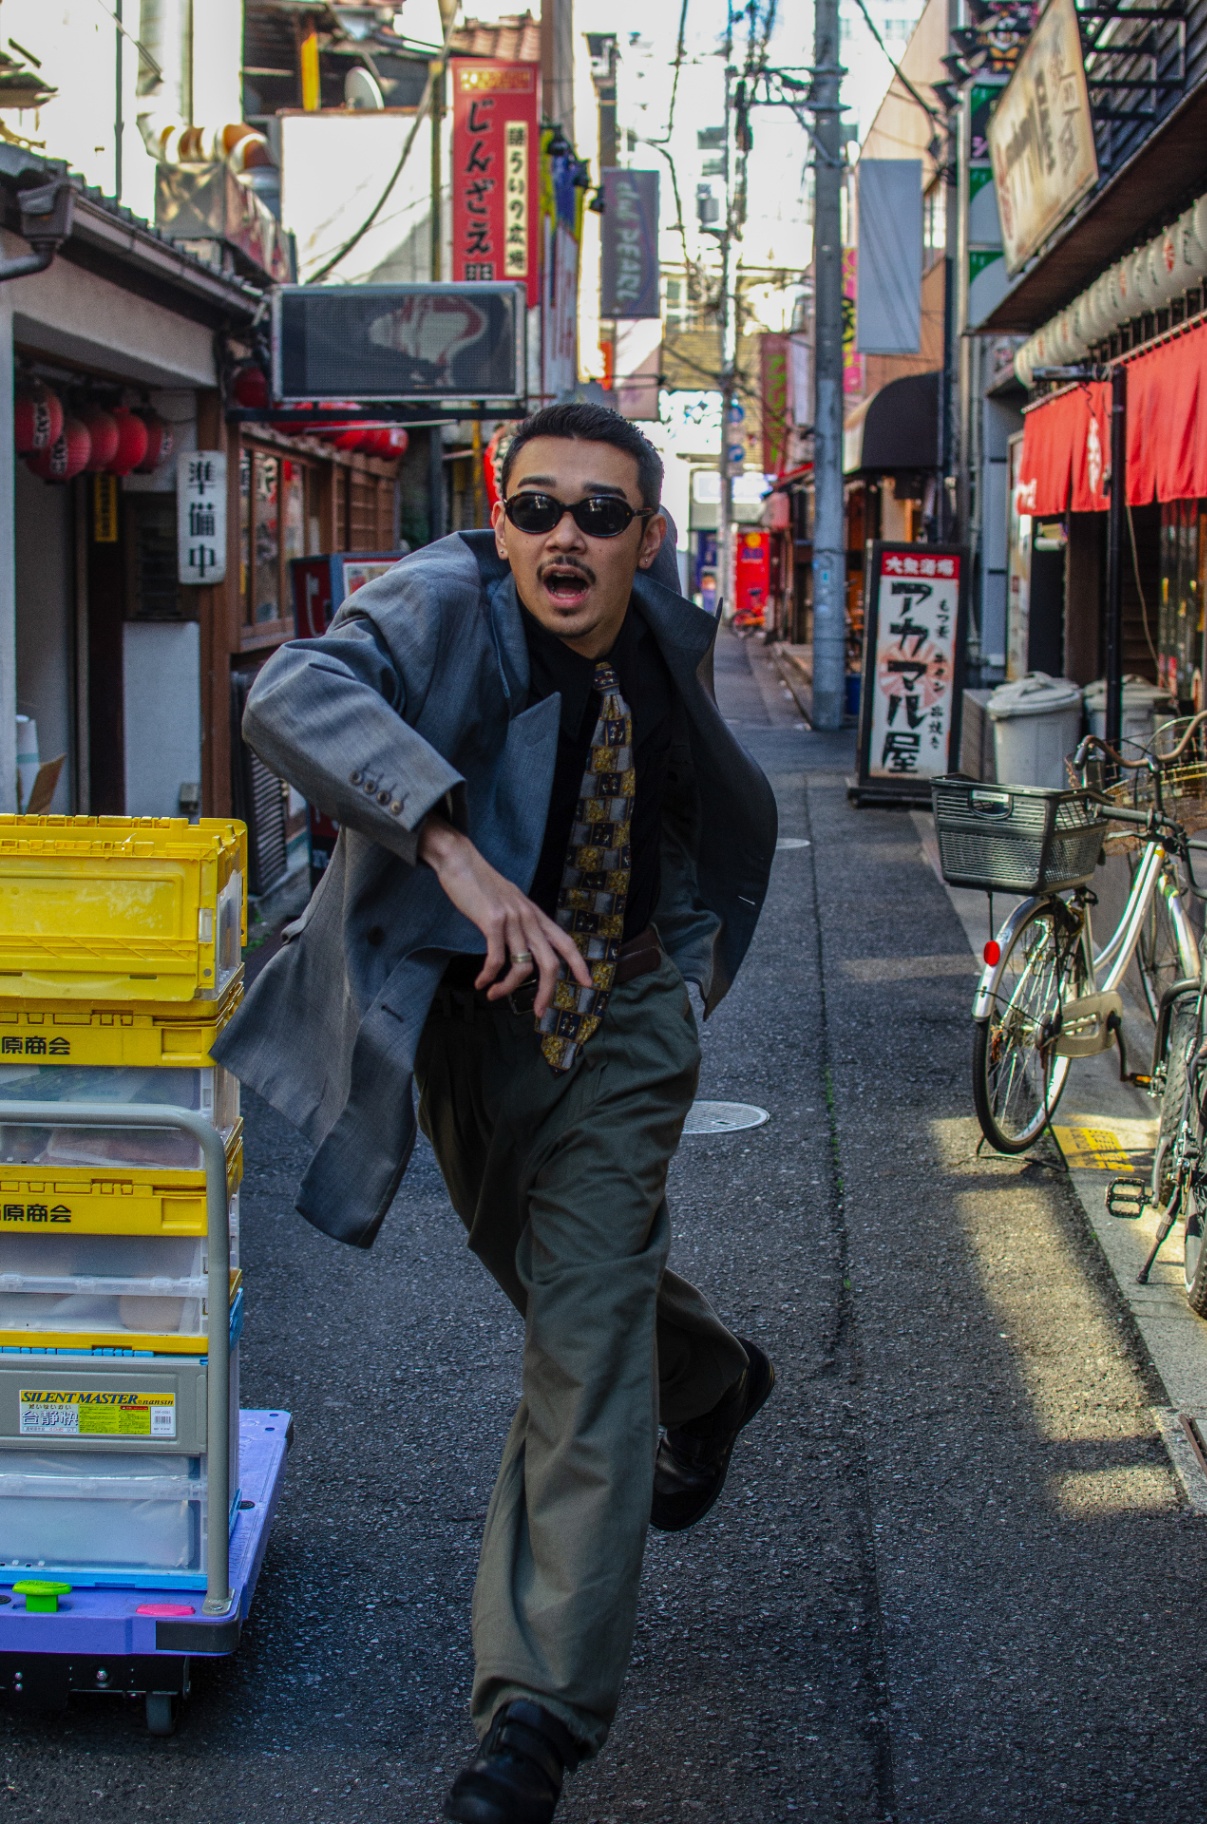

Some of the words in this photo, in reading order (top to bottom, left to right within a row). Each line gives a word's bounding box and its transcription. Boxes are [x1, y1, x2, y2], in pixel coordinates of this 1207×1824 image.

[188, 460, 217, 578] 準備中
[885, 555, 955, 578] 大衆酒場
[881, 581, 934, 775] アカマル屋
[0, 1203, 72, 1223] 原商会
[21, 1391, 76, 1403] SILENT
[76, 1393, 138, 1405] MASTER
